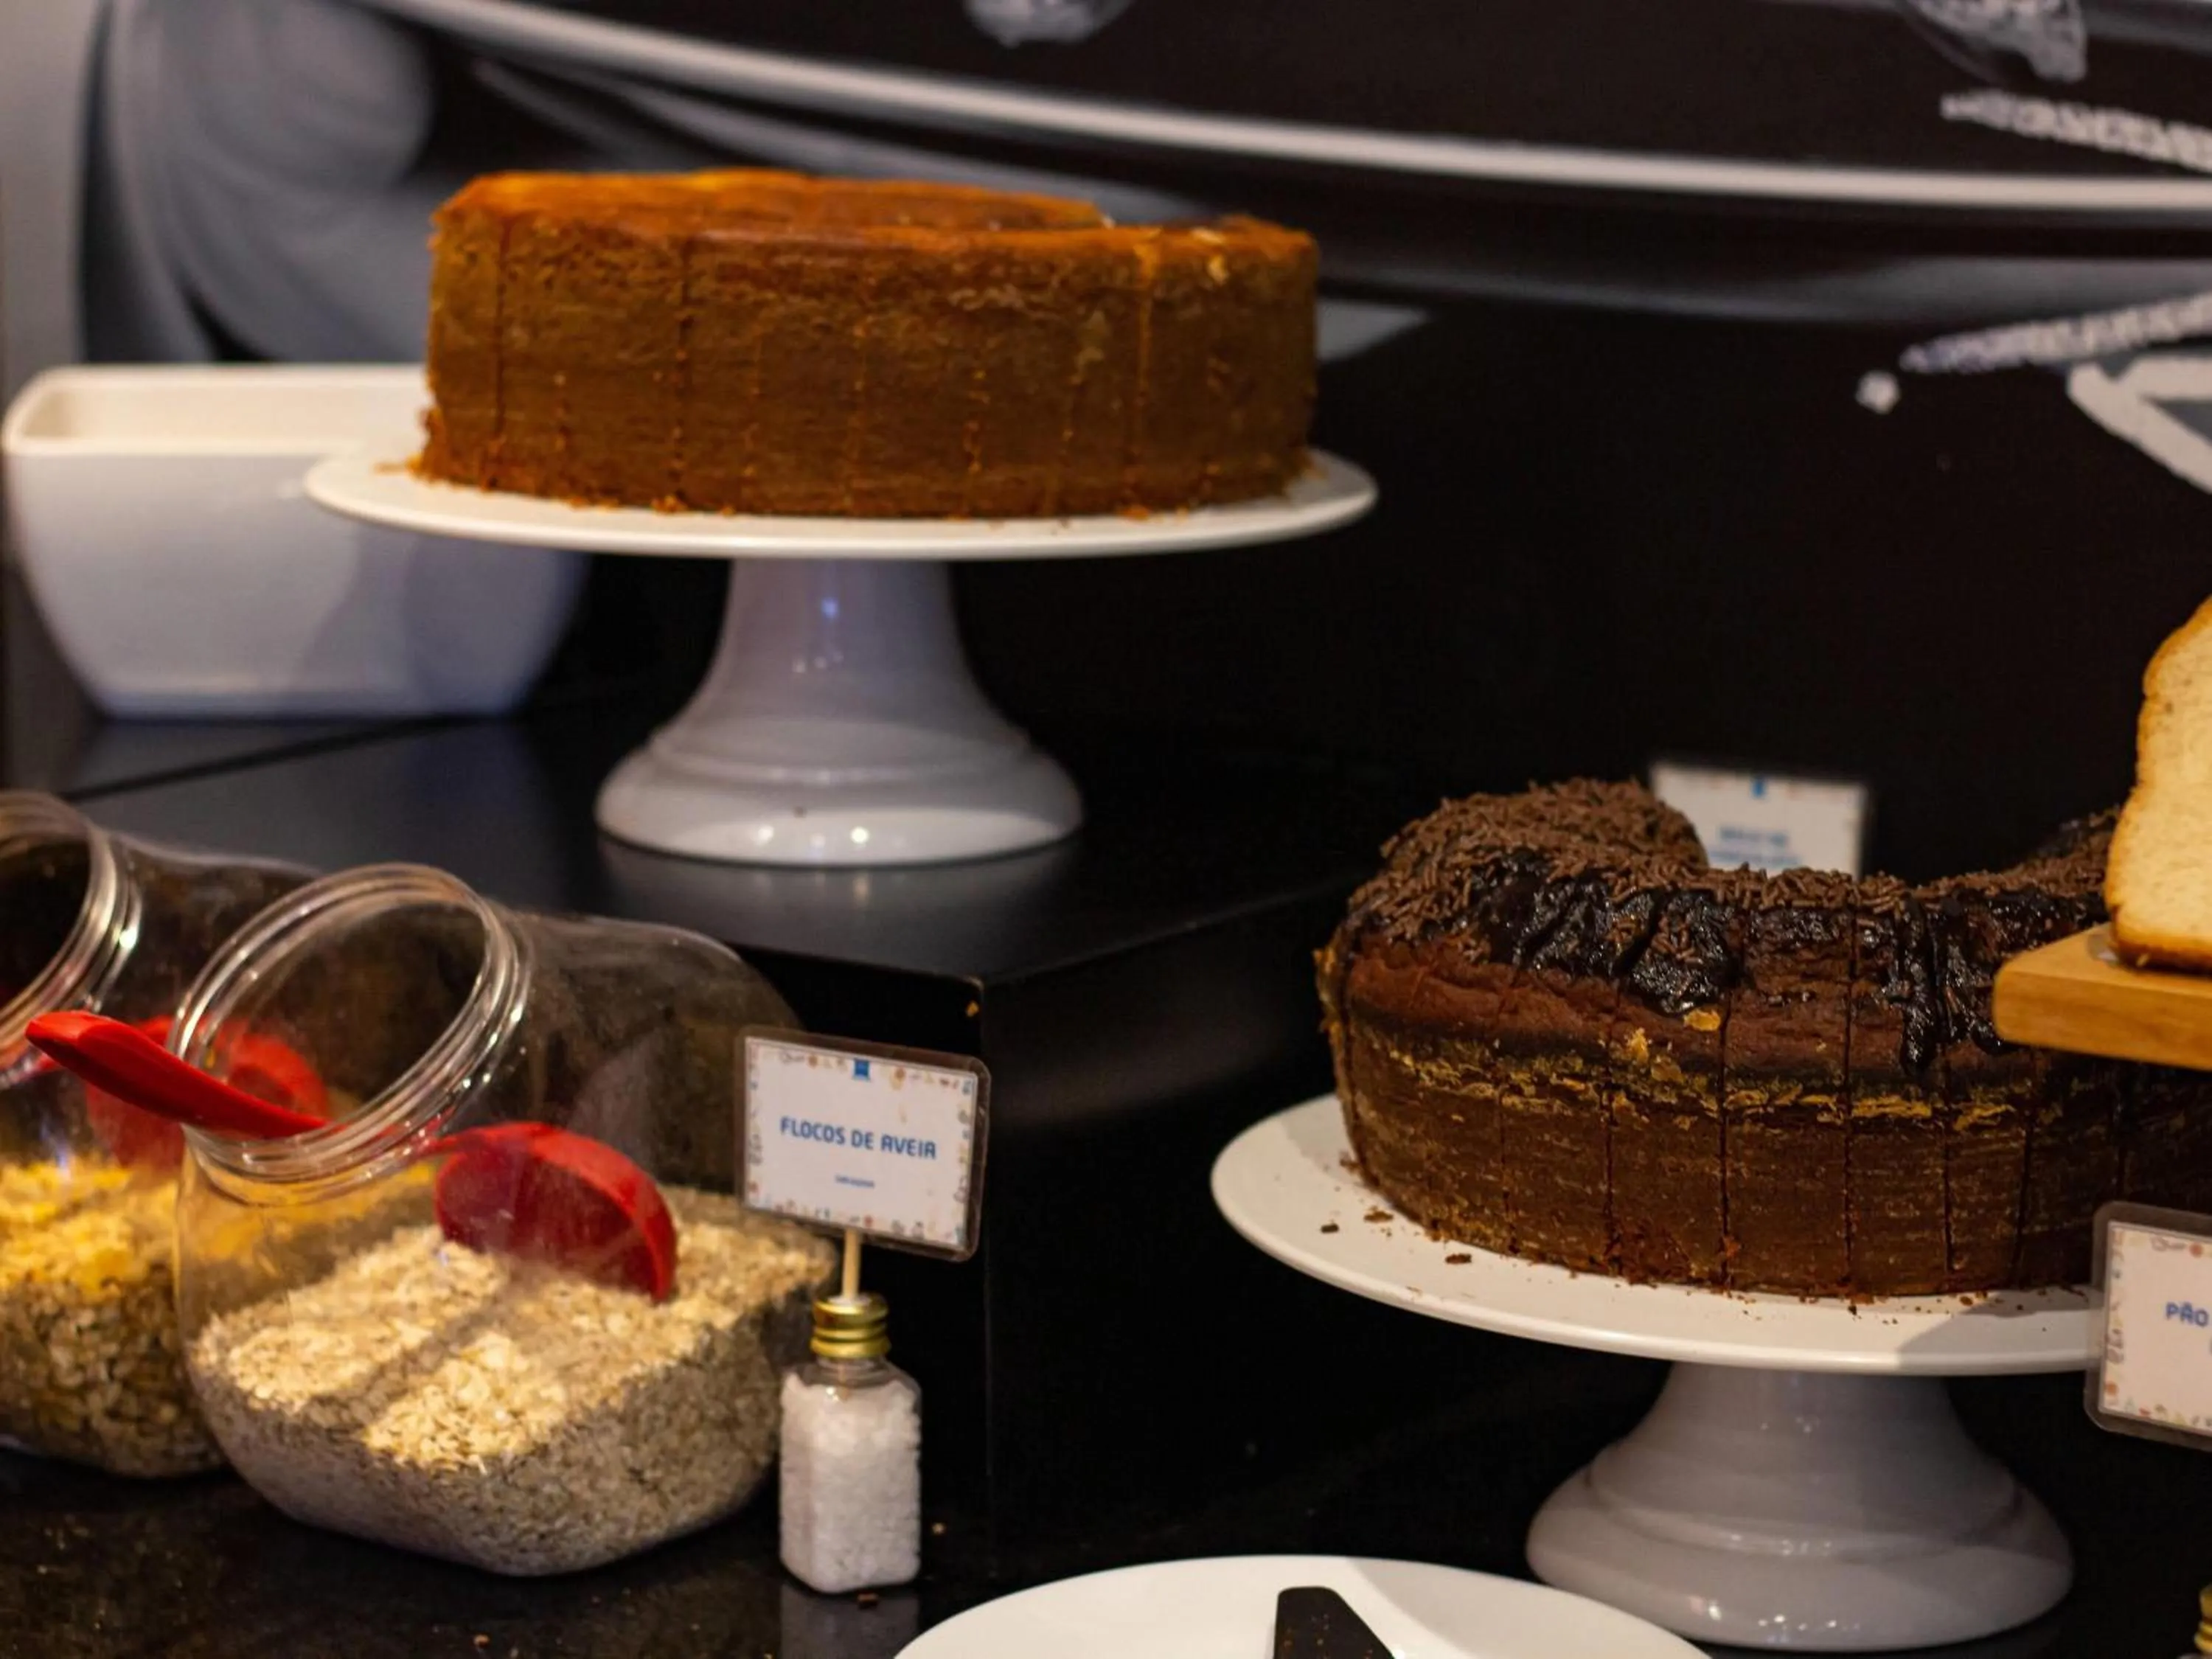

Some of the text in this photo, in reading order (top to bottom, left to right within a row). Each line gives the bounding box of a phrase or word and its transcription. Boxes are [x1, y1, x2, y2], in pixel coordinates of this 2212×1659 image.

[779, 1116, 936, 1160] FLOCOS DE AVEIA
[2165, 1301, 2209, 1328] PÃO
